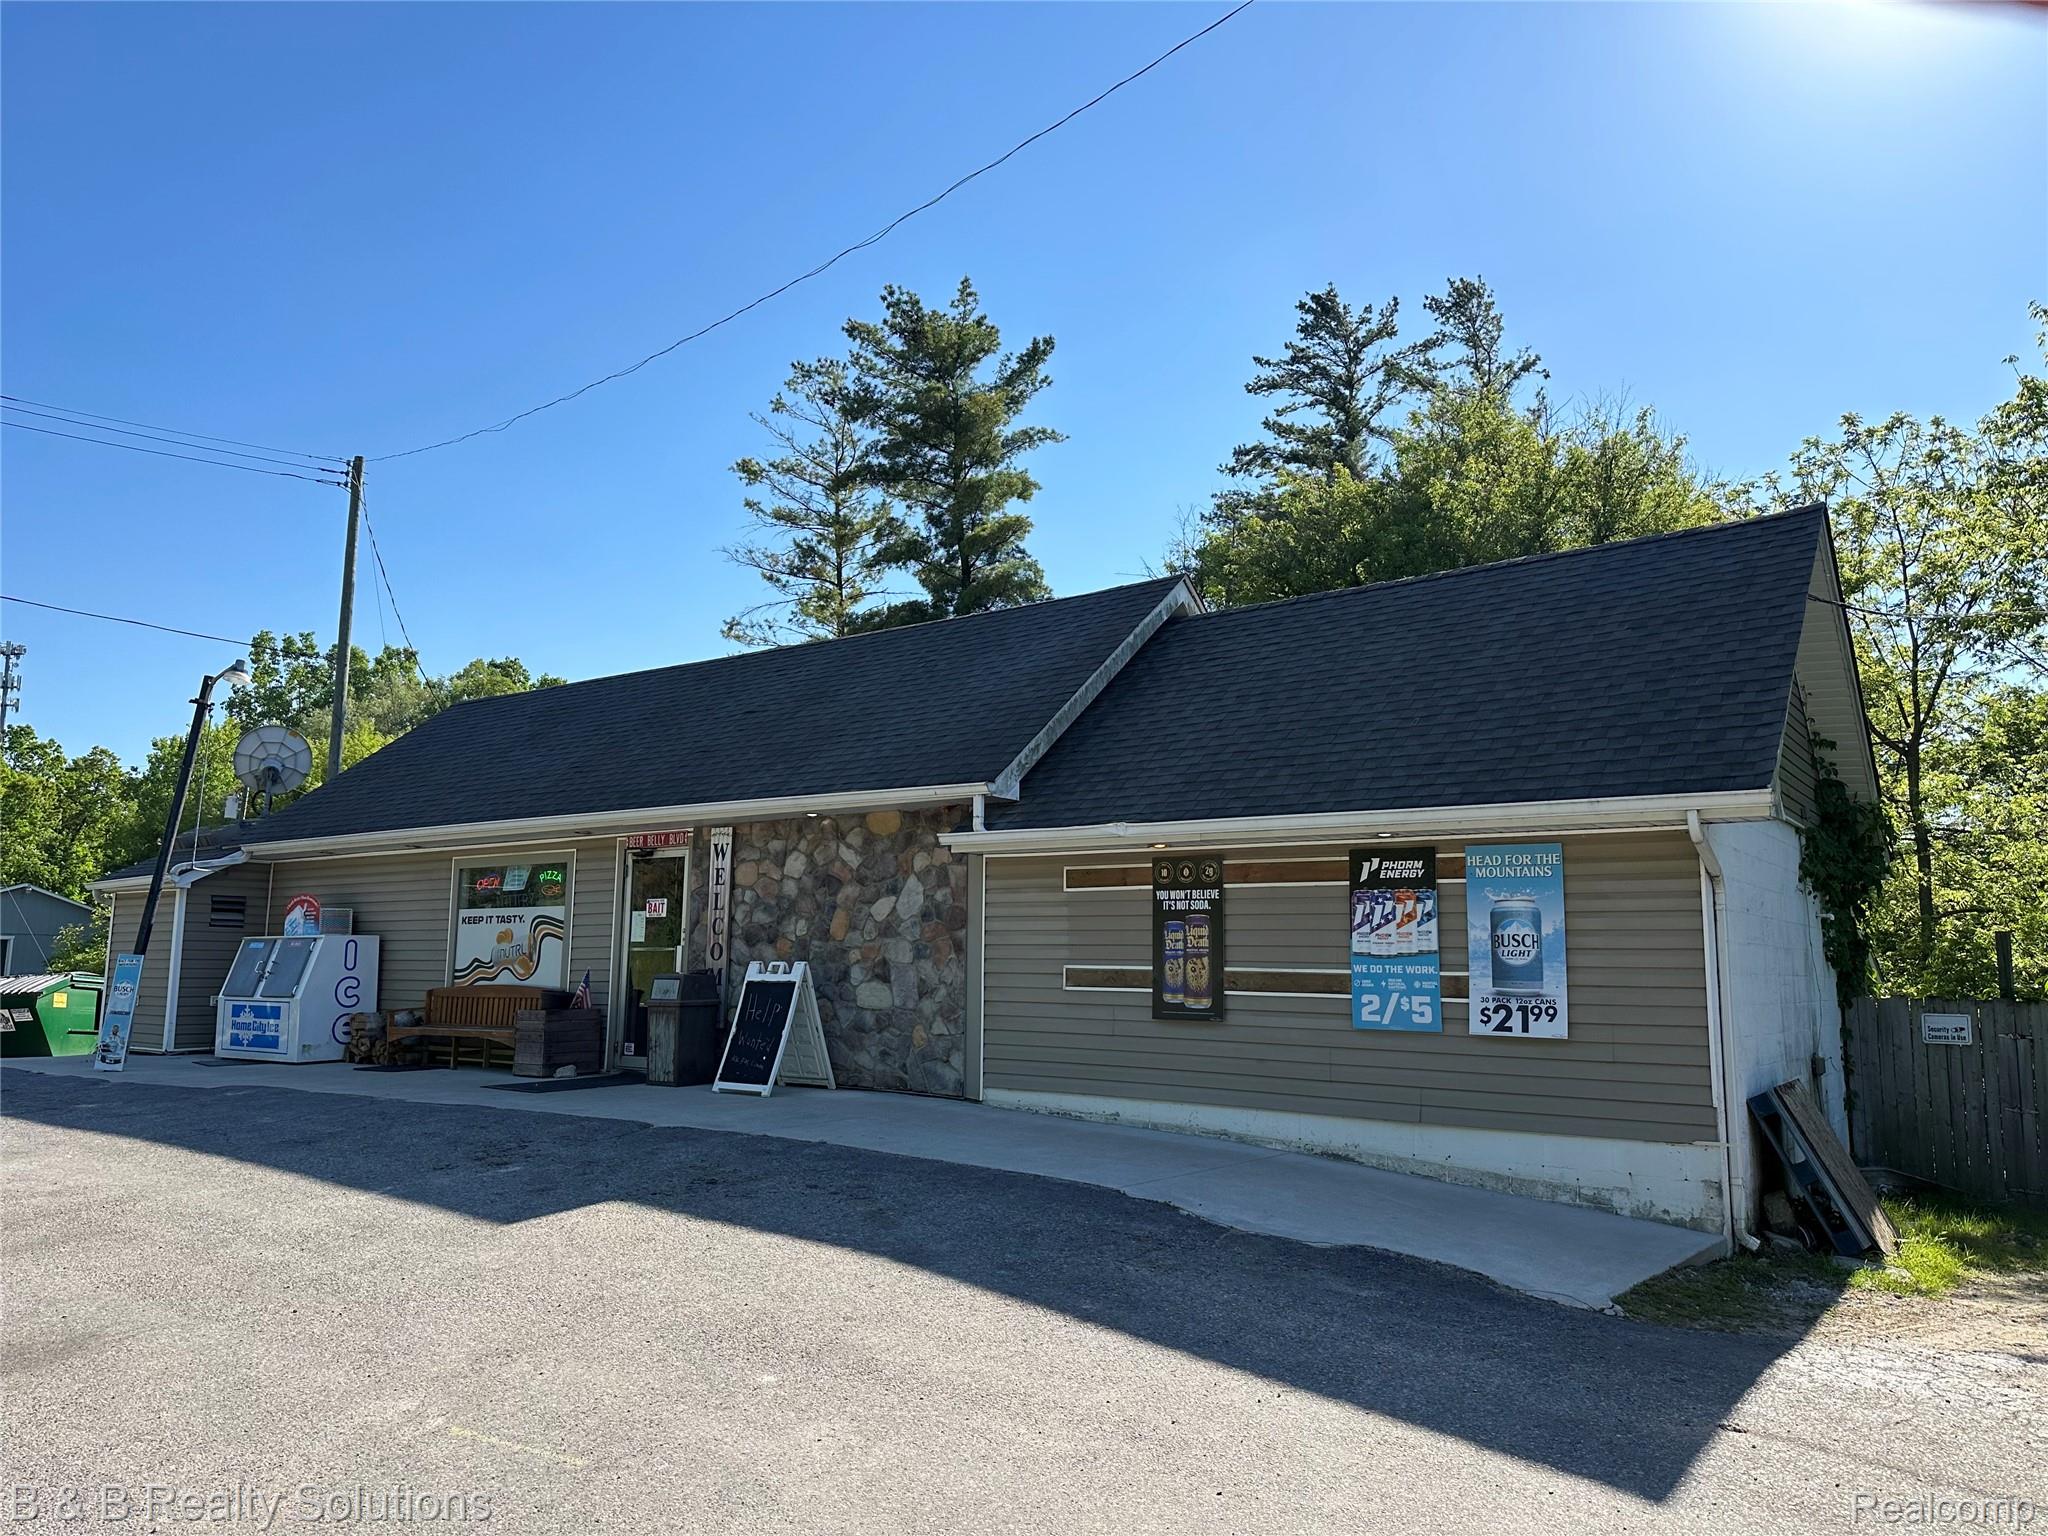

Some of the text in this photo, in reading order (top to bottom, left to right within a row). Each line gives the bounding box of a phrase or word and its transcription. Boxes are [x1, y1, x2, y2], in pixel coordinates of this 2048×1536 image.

[629, 832, 684, 848] BEER BELLY BLVD
[1381, 860, 1423, 870] PHORM
[1467, 853, 1560, 866] HEAD FOR THE
[539, 870, 562, 883] PIZZA
[1379, 869, 1425, 879] ENERGY
[1475, 865, 1553, 878] MOUNTAINS
[476, 878, 501, 892] OPEN
[1156, 889, 1220, 900] YOU WON'T BELIEVE
[647, 902, 666, 914] BAIT
[1163, 900, 1212, 910] IT'S NOT SODA.
[461, 914, 526, 925] KEEP IT TASTY.
[707, 842, 730, 986] WELCOM
[1493, 933, 1540, 950] BUSCH
[1353, 964, 1438, 974] WE DO THE WORK.
[114, 985, 135, 993] BUSCH
[1534, 998, 1557, 1006] CANS
[748, 994, 788, 1029] Help
[1361, 992, 1433, 1025] 2/$5
[231, 1019, 251, 1031] Home
[1927, 1025, 1949, 1034] Security
